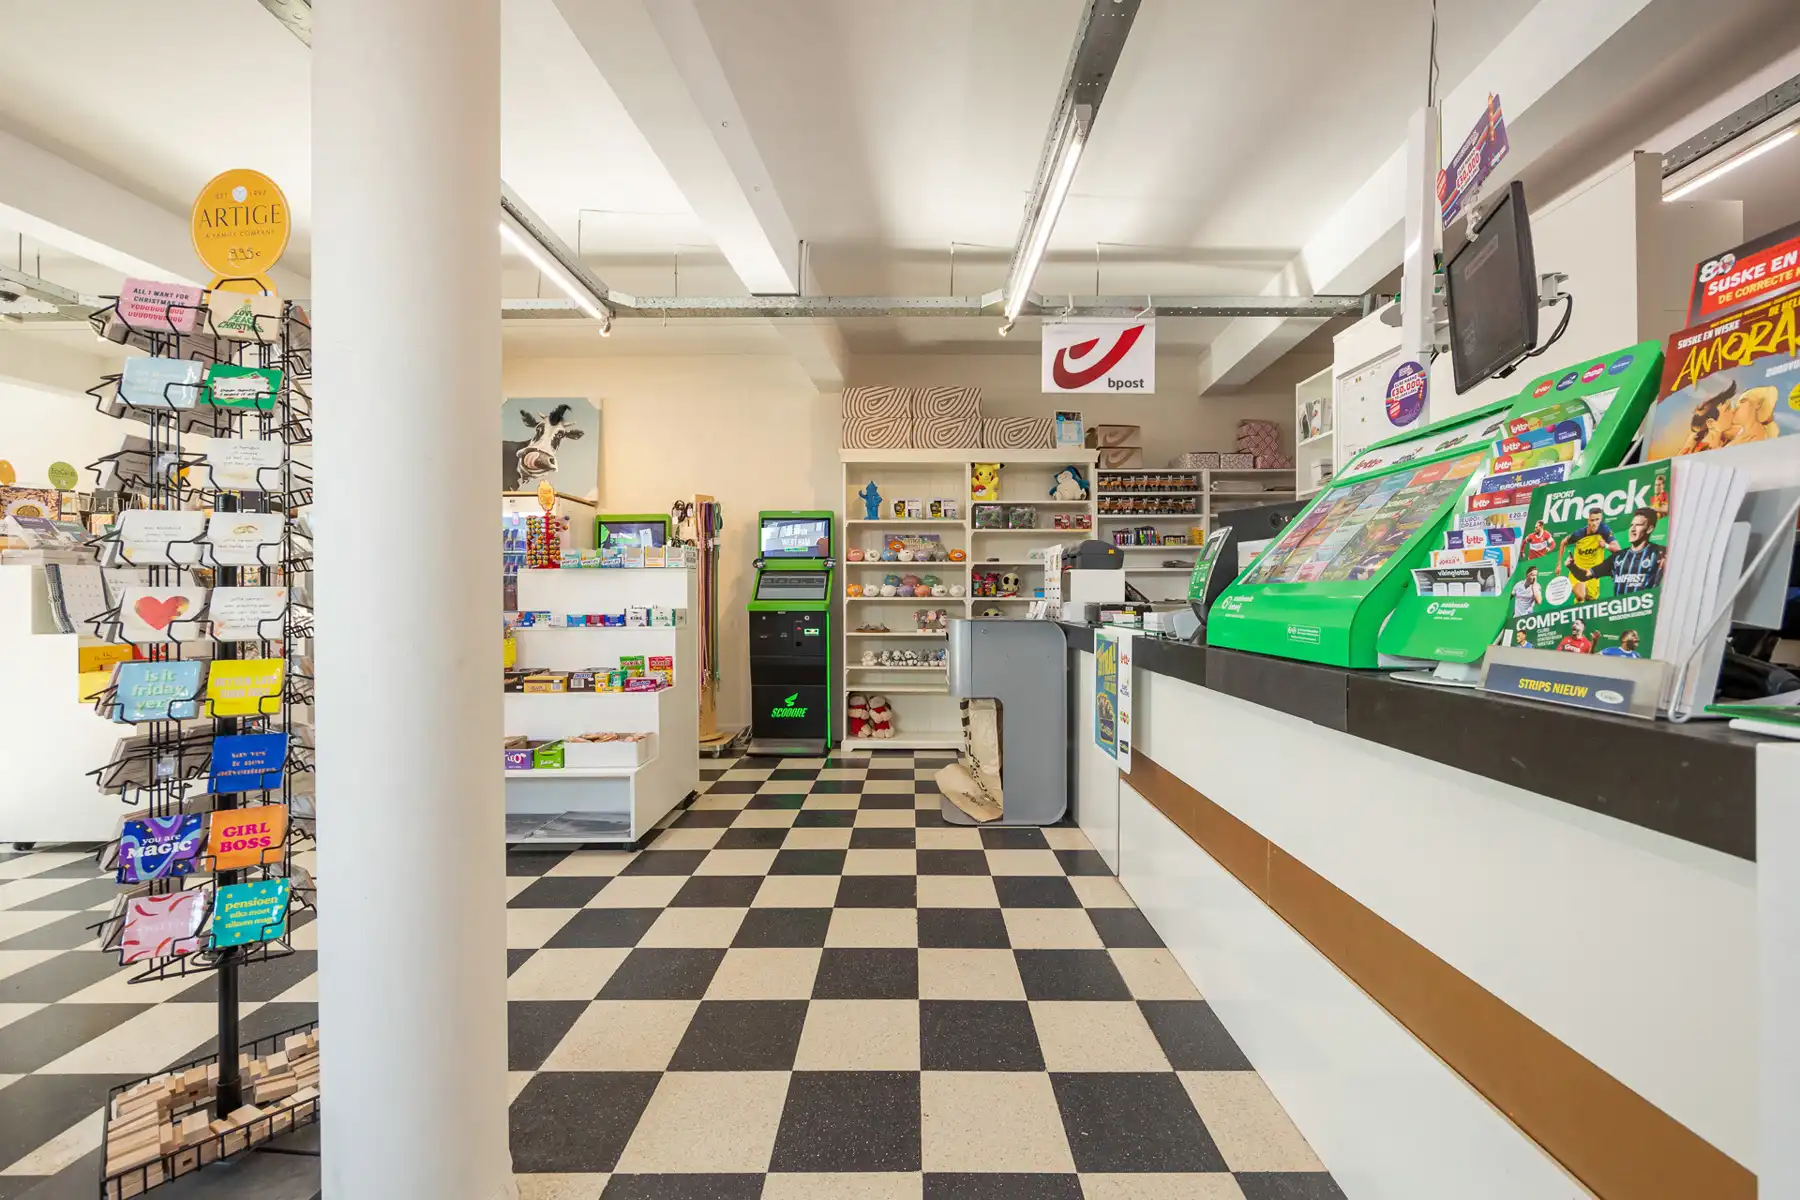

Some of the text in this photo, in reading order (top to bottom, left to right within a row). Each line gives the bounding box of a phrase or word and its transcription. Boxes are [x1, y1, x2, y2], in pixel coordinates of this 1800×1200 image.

[199, 203, 282, 229] ARTIGE
[1708, 262, 1767, 296] SUSKE
[1770, 249, 1798, 273] EN
[1718, 291, 1733, 305] DE
[1735, 269, 1794, 299] CORRECTE
[153, 291, 174, 299] WANT
[175, 292, 190, 300] FOR
[1678, 334, 1703, 350] SUSKE
[1702, 329, 1714, 341] EN
[1714, 320, 1740, 336] WISKE
[1107, 377, 1144, 390] bpost
[1392, 378, 1420, 397] €30.000
[1510, 423, 1528, 434] lotto
[1503, 442, 1521, 453] lotto
[1354, 459, 1382, 470] lotto
[1494, 461, 1512, 471] lotto
[1500, 478, 1541, 490] EUROMILLIONS
[1552, 489, 1576, 501] SPORT
[1473, 499, 1490, 509] lotto
[1466, 535, 1484, 545] lotto
[1438, 569, 1470, 578] vikinglotto
[1516, 593, 1654, 632] COMPETITIEGIDS
[144, 667, 176, 683] is it
[1518, 678, 1589, 698] STRIPS NIEUW
[771, 707, 809, 718] SCOOORE
[222, 822, 271, 838] GIRL
[142, 833, 181, 846] you are
[220, 836, 271, 853] BOSS
[225, 896, 279, 912] pensioen
